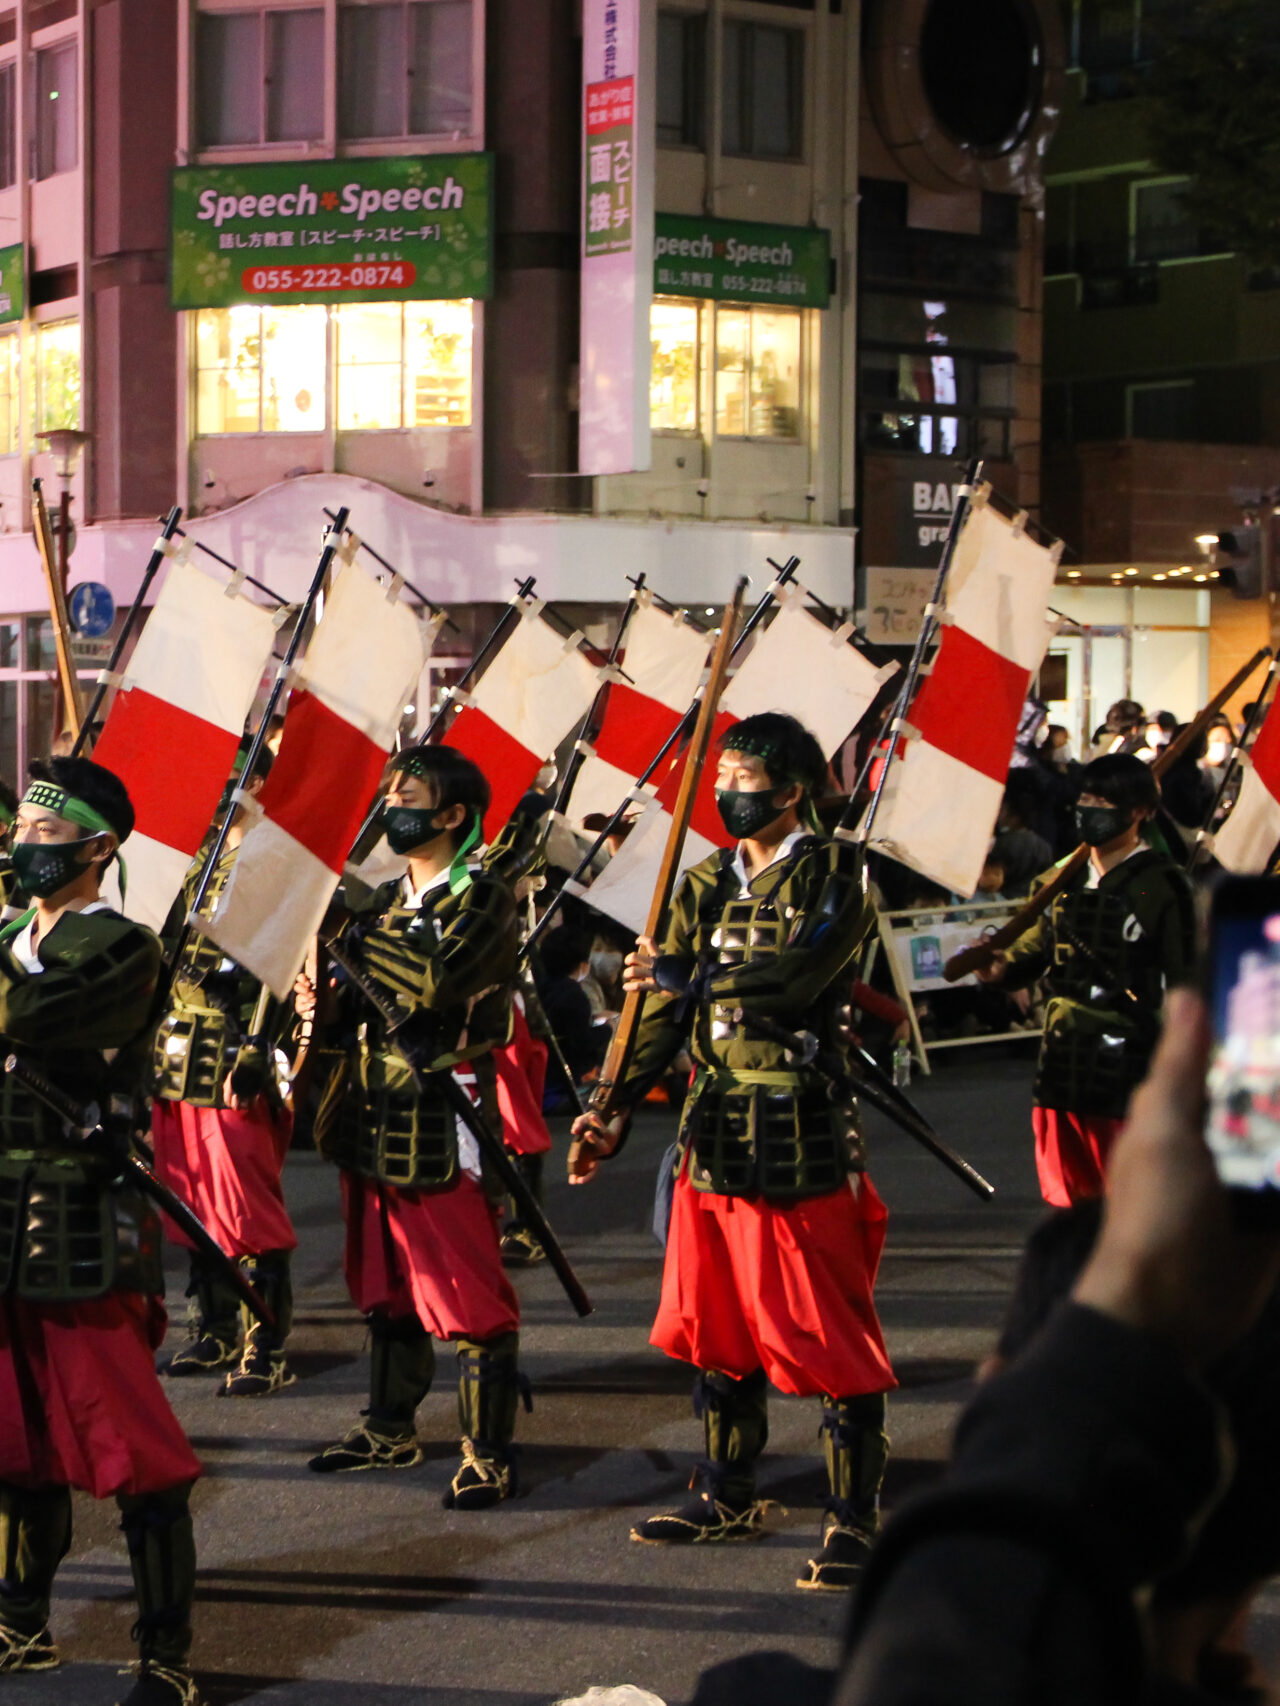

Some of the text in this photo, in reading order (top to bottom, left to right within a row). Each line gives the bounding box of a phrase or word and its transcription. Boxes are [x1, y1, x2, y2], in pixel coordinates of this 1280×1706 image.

[589, 143, 612, 232] 面接
[613, 140, 631, 229] スピーチ
[197, 177, 464, 227] Speech Speech
[219, 230, 295, 249] 話し方教室
[654, 234, 714, 261] peech
[725, 238, 793, 267] Speech
[252, 266, 404, 290] 055-222-0874
[918, 526, 951, 546] gra
